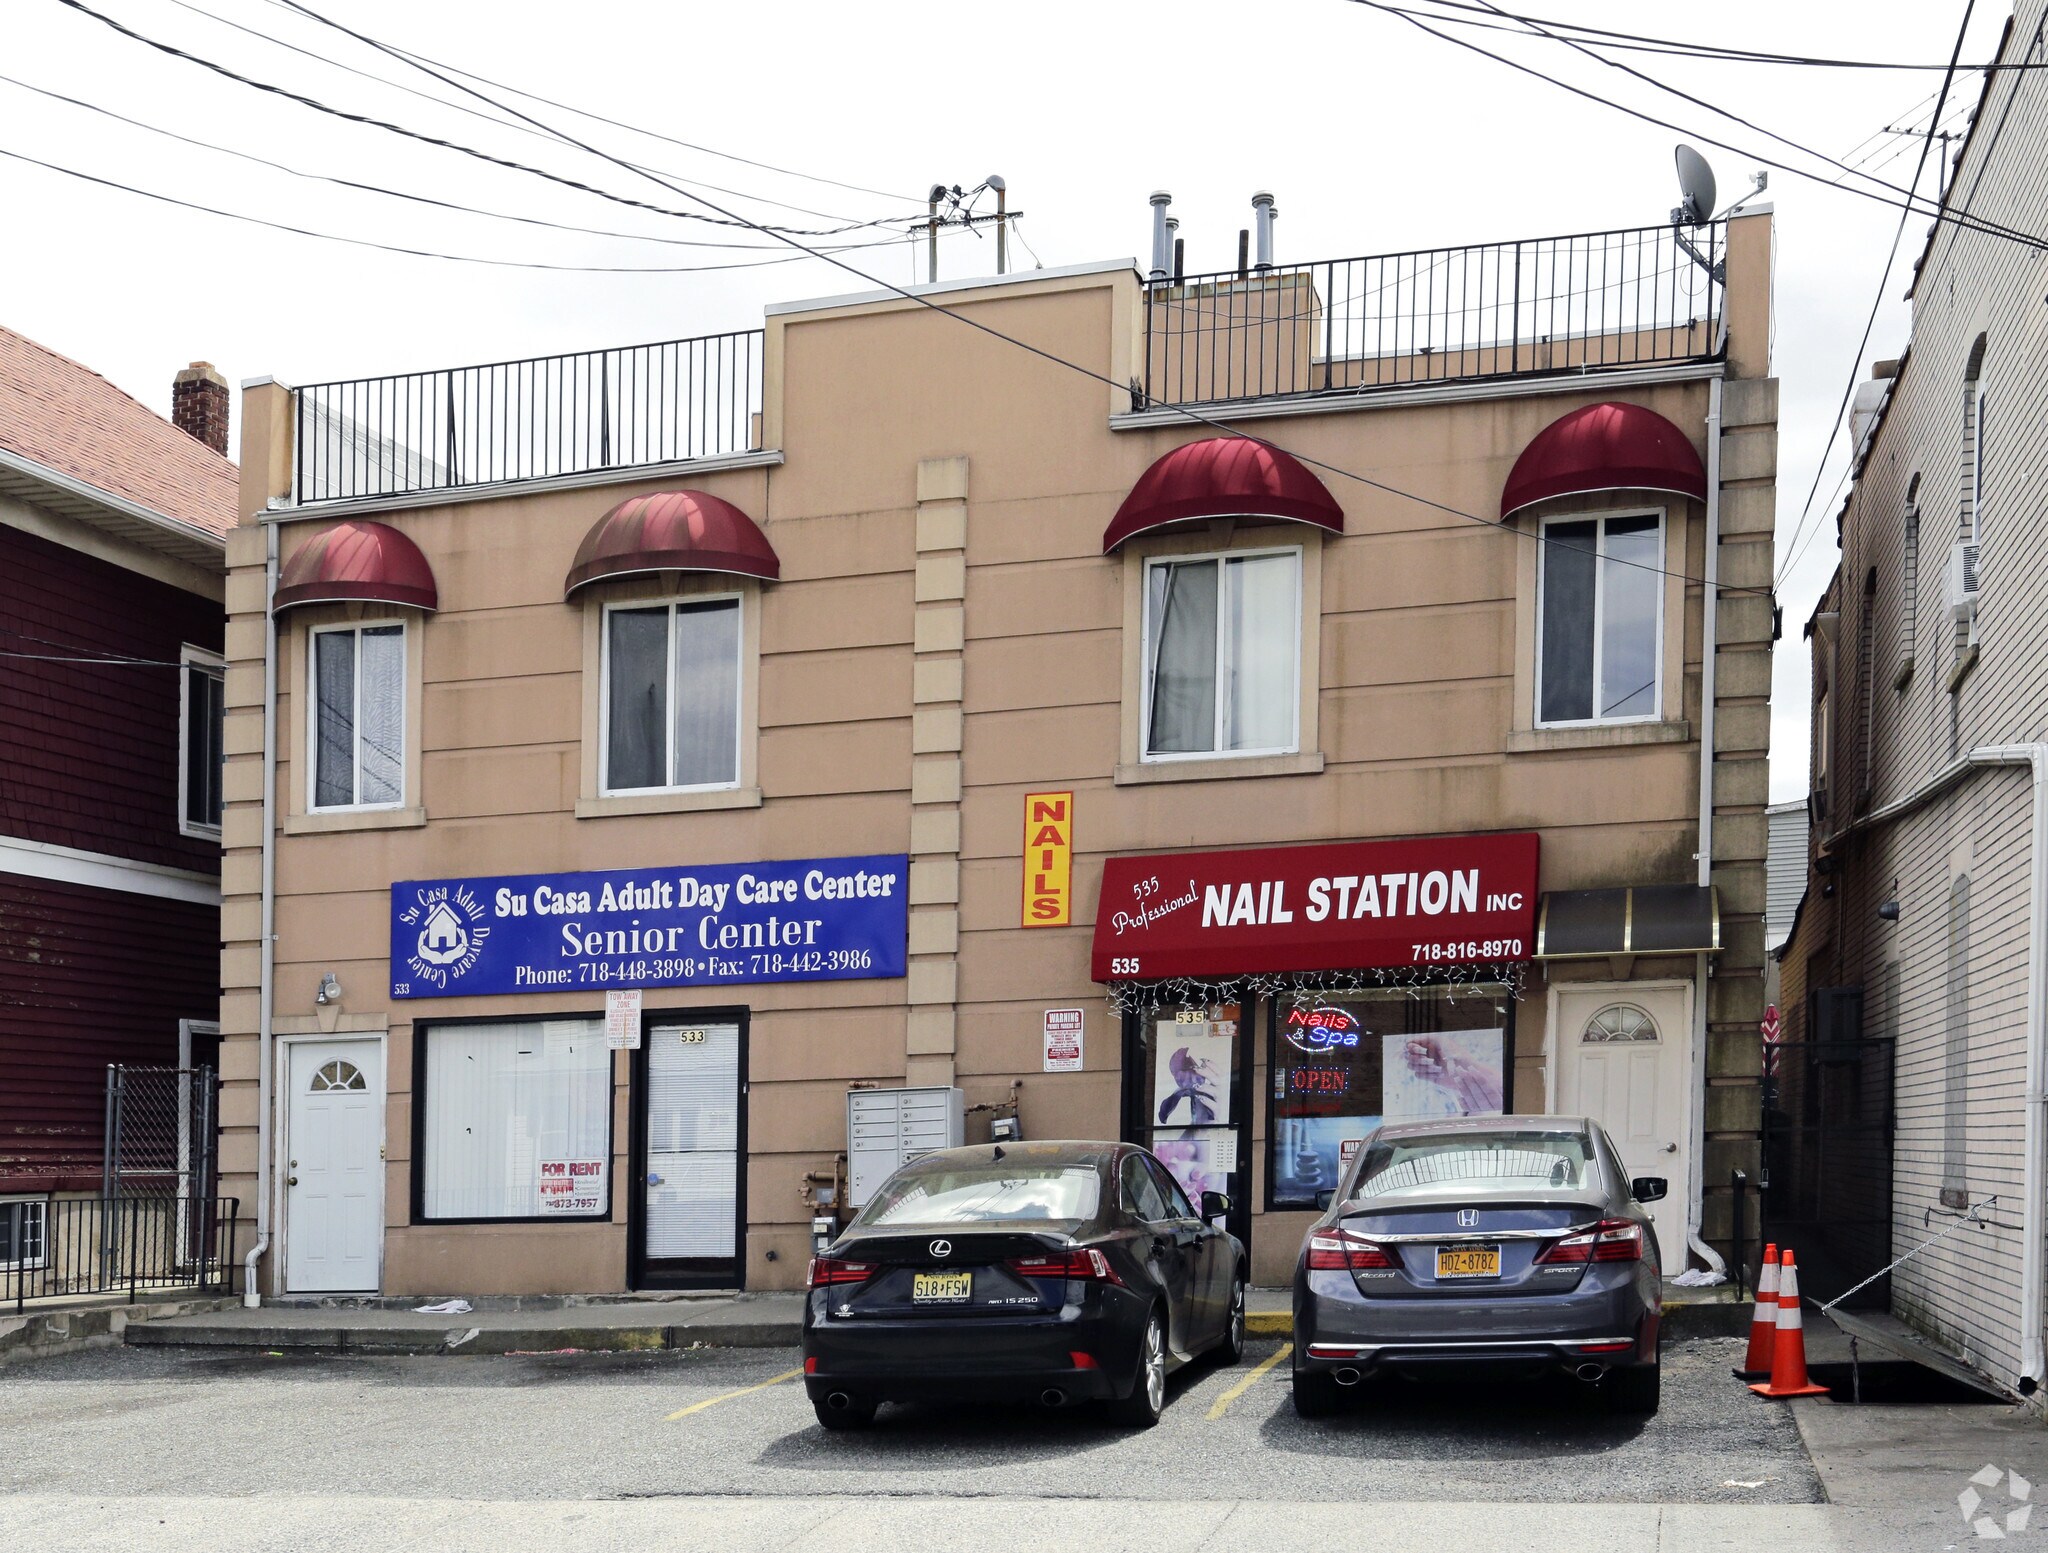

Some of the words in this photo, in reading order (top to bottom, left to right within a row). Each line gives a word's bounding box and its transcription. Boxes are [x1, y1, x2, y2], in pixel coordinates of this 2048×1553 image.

[1031, 800, 1065, 919] NAILS
[417, 887, 448, 907] Casa
[495, 887, 528, 917] Su
[533, 886, 591, 916] Casa
[597, 880, 673, 912] Adult
[678, 877, 730, 912] Day
[736, 874, 798, 905] Care
[803, 869, 896, 901] Center
[1133, 876, 1160, 900] 535
[452, 884, 486, 922] Adult
[1112, 880, 1199, 935] Professional
[1202, 881, 1293, 928] NAIL
[1306, 869, 1479, 922] STATION
[1486, 893, 1523, 912] INC
[399, 906, 420, 925] Su
[561, 919, 684, 957] Senior
[699, 915, 822, 950] Center
[452, 927, 491, 979] Daycare
[1412, 939, 1522, 961] 718-816-8970
[407, 955, 447, 990] Center
[515, 965, 572, 985] Phone:
[578, 958, 695, 982] 718-448-3898
[708, 957, 744, 976] Fax:
[751, 949, 872, 974] 718-442-3986
[1111, 958, 1140, 974] 535
[394, 983, 410, 995] 533
[1049, 1012, 1079, 1023] WARNING
[1177, 1012, 1203, 1023] 535
[1288, 1010, 1349, 1029] Nails
[681, 1031, 704, 1043] 533
[1309, 1026, 1359, 1046] Spa
[1294, 1070, 1345, 1090] OPEN
[542, 1163, 566, 1176] FOR
[569, 1163, 601, 1176] RENT
[1441, 1254, 1460, 1271] HDZ
[1468, 1253, 1494, 1270] 8782
[1543, 1266, 1580, 1274] SPORT
[1357, 1271, 1396, 1279] Accord
[1017, 1296, 1038, 1304] 250
